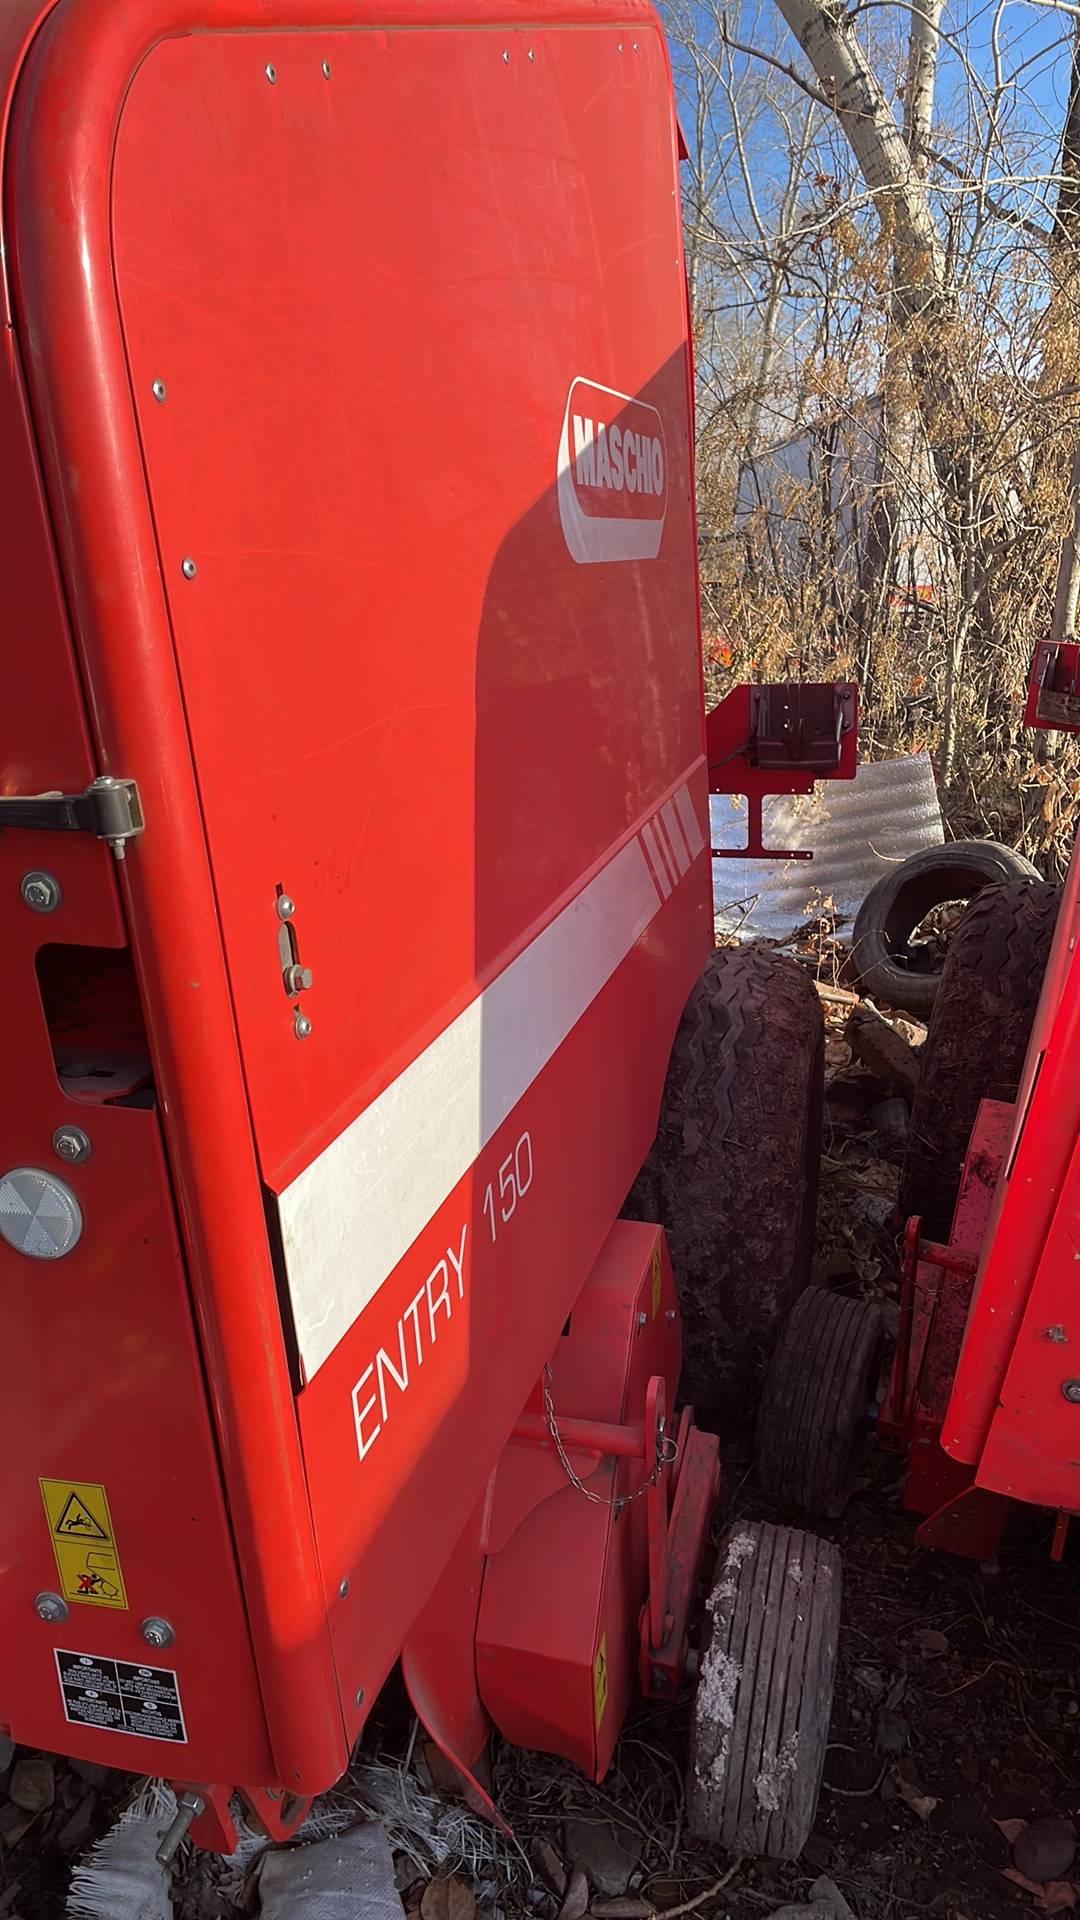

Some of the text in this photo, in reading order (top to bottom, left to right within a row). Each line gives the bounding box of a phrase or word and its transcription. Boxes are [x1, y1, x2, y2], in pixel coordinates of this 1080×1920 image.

[573, 415, 664, 496] MASCHIO
[351, 1131, 534, 1462] ENTRY 150
